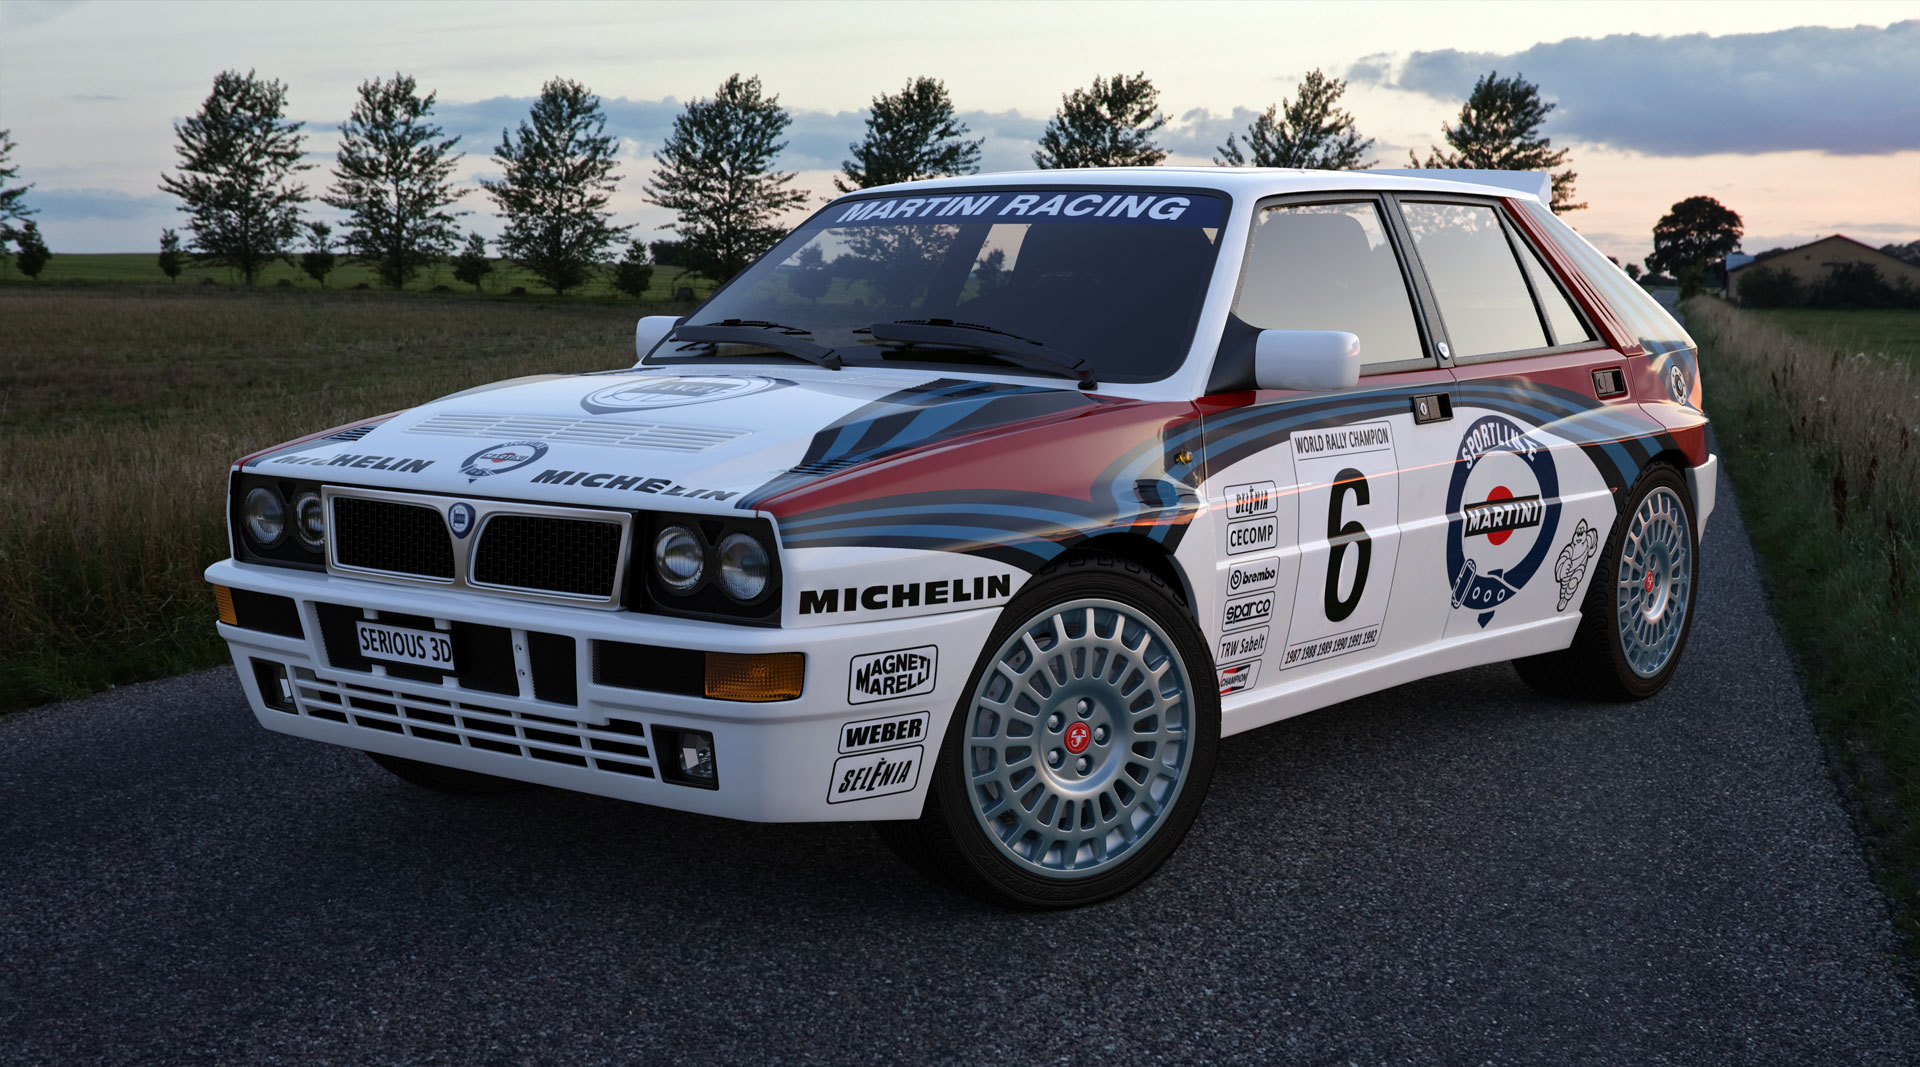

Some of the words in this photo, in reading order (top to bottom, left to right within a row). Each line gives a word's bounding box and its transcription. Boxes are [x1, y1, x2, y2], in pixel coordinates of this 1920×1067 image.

[836, 196, 1000, 223] MARTINI
[997, 194, 1190, 221] RACING
[1295, 435, 1324, 454] WORLD
[1325, 432, 1347, 450] RALLY
[1348, 427, 1389, 448] CHAMPION
[1462, 423, 1538, 469] SPORTLINE
[273, 454, 436, 473] MICHELIN
[530, 469, 739, 501] MICHELIN
[1468, 501, 1538, 532] MARTINI
[1230, 524, 1274, 547] CECOMP
[1324, 467, 1372, 622] 6
[1242, 567, 1275, 585] brembo
[799, 574, 1010, 615] MICHELIN
[1226, 599, 1270, 624] sparco
[361, 627, 426, 659] SERIOUS
[430, 637, 451, 662] 3D
[1221, 640, 1239, 658] TRW
[1240, 633, 1264, 654] Sabelt
[1285, 648, 1301, 664] 1987
[1301, 644, 1318, 660] 1988
[1317, 641, 1333, 656] 1989
[1332, 637, 1348, 652] 1990
[1347, 633, 1363, 648] 1991
[1362, 629, 1377, 644] 1992
[856, 654, 930, 682] MAGNETI
[856, 668, 930, 695] MARELLI
[1221, 673, 1248, 687] CHAMPION
[846, 718, 922, 748] WEBER
